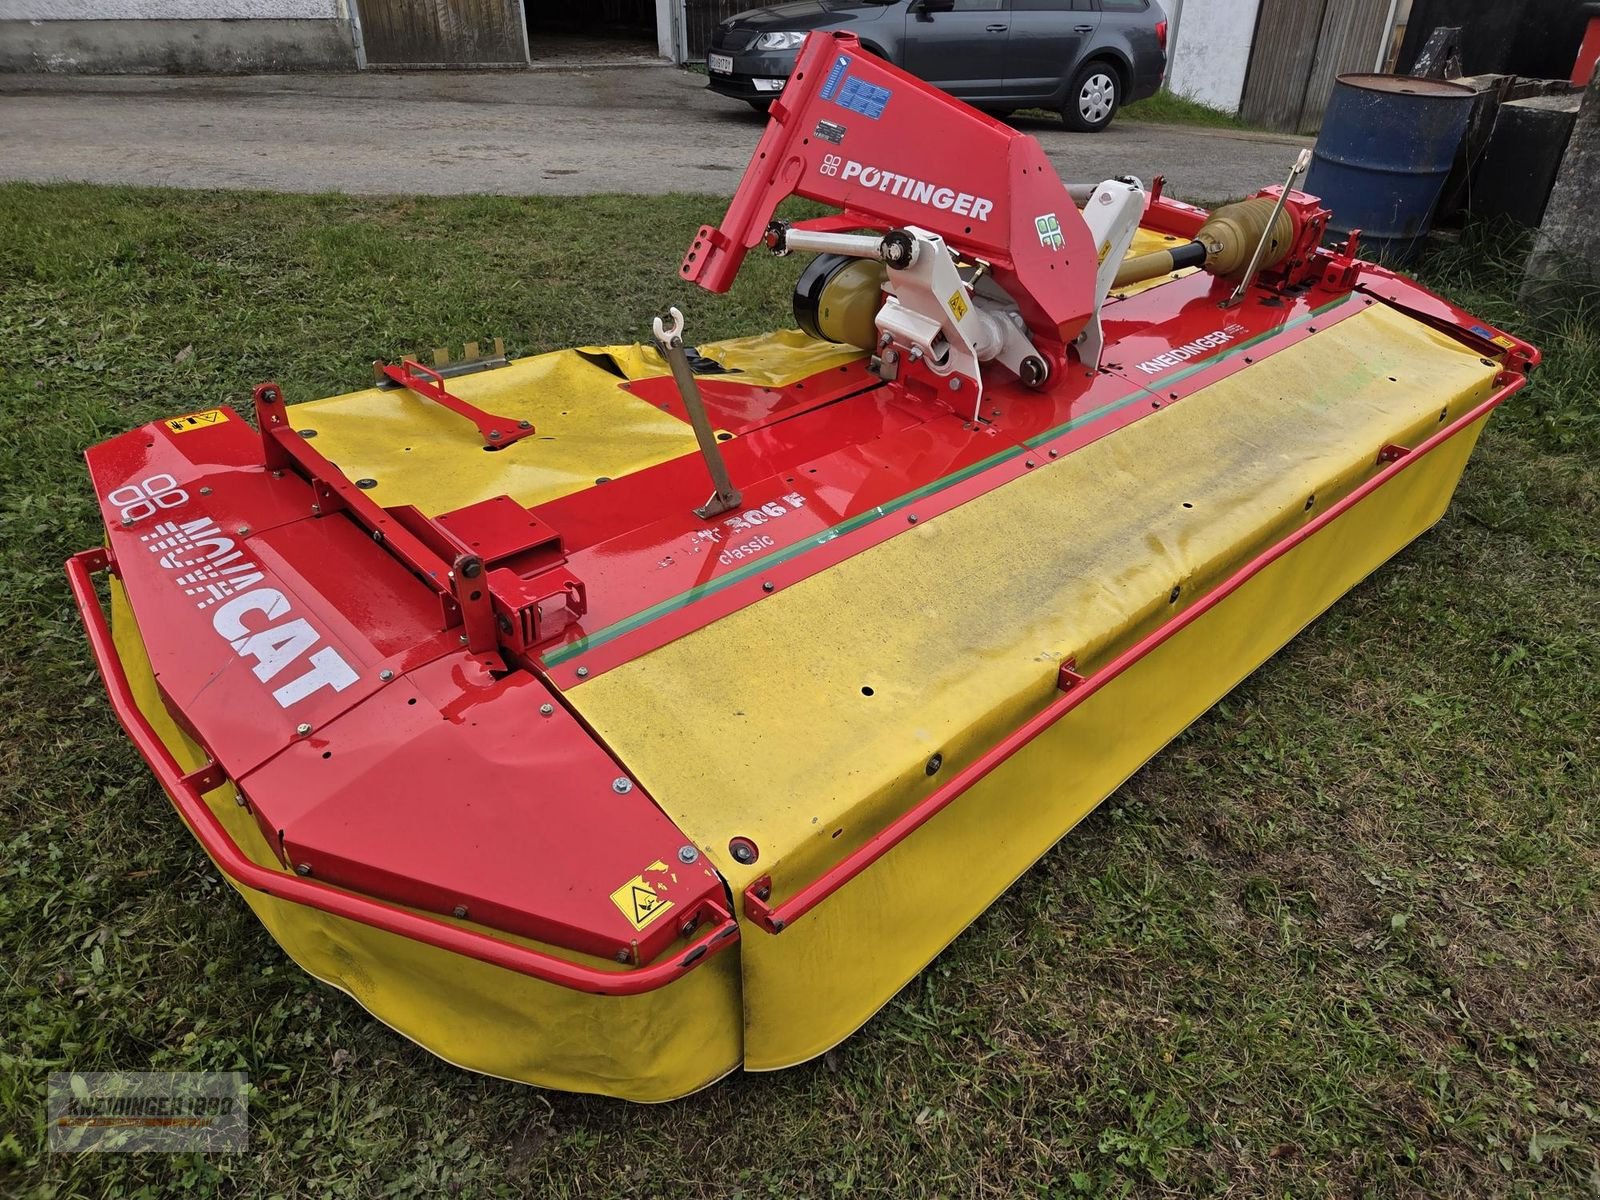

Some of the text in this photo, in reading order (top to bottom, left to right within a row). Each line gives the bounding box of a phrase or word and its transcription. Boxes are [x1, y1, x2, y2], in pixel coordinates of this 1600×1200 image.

[1136, 330, 1234, 374] KNEIDINGER
[782, 491, 806, 508] F
[719, 535, 774, 565] classic
